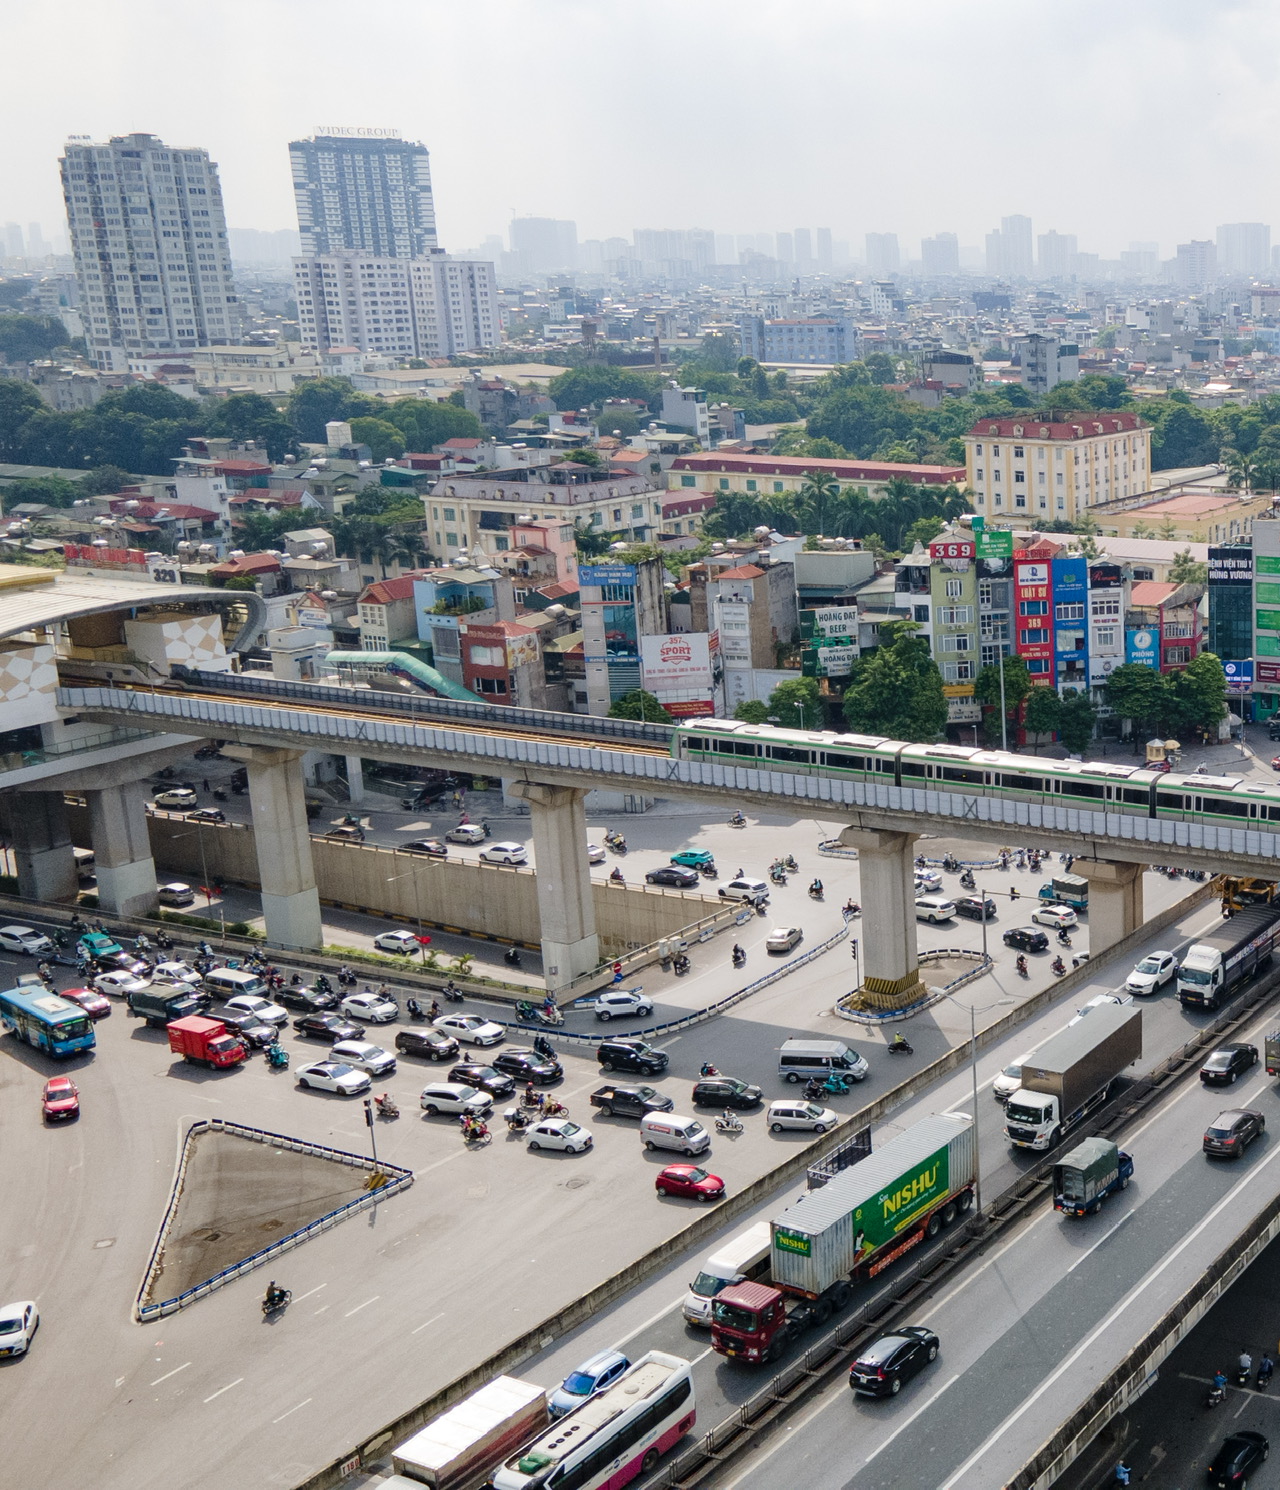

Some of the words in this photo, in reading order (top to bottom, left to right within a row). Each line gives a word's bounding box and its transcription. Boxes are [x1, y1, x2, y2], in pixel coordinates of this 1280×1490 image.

[318, 126, 355, 136] VIDEC
[357, 127, 398, 137] GROUP
[935, 545, 971, 557] 369
[153, 568, 177, 583] 329
[818, 612, 843, 621] HOÀNG
[830, 624, 847, 634] BEER
[660, 646, 691, 656] SPORT
[883, 1165, 937, 1218] NISHU
[779, 1236, 809, 1251] NISHU
